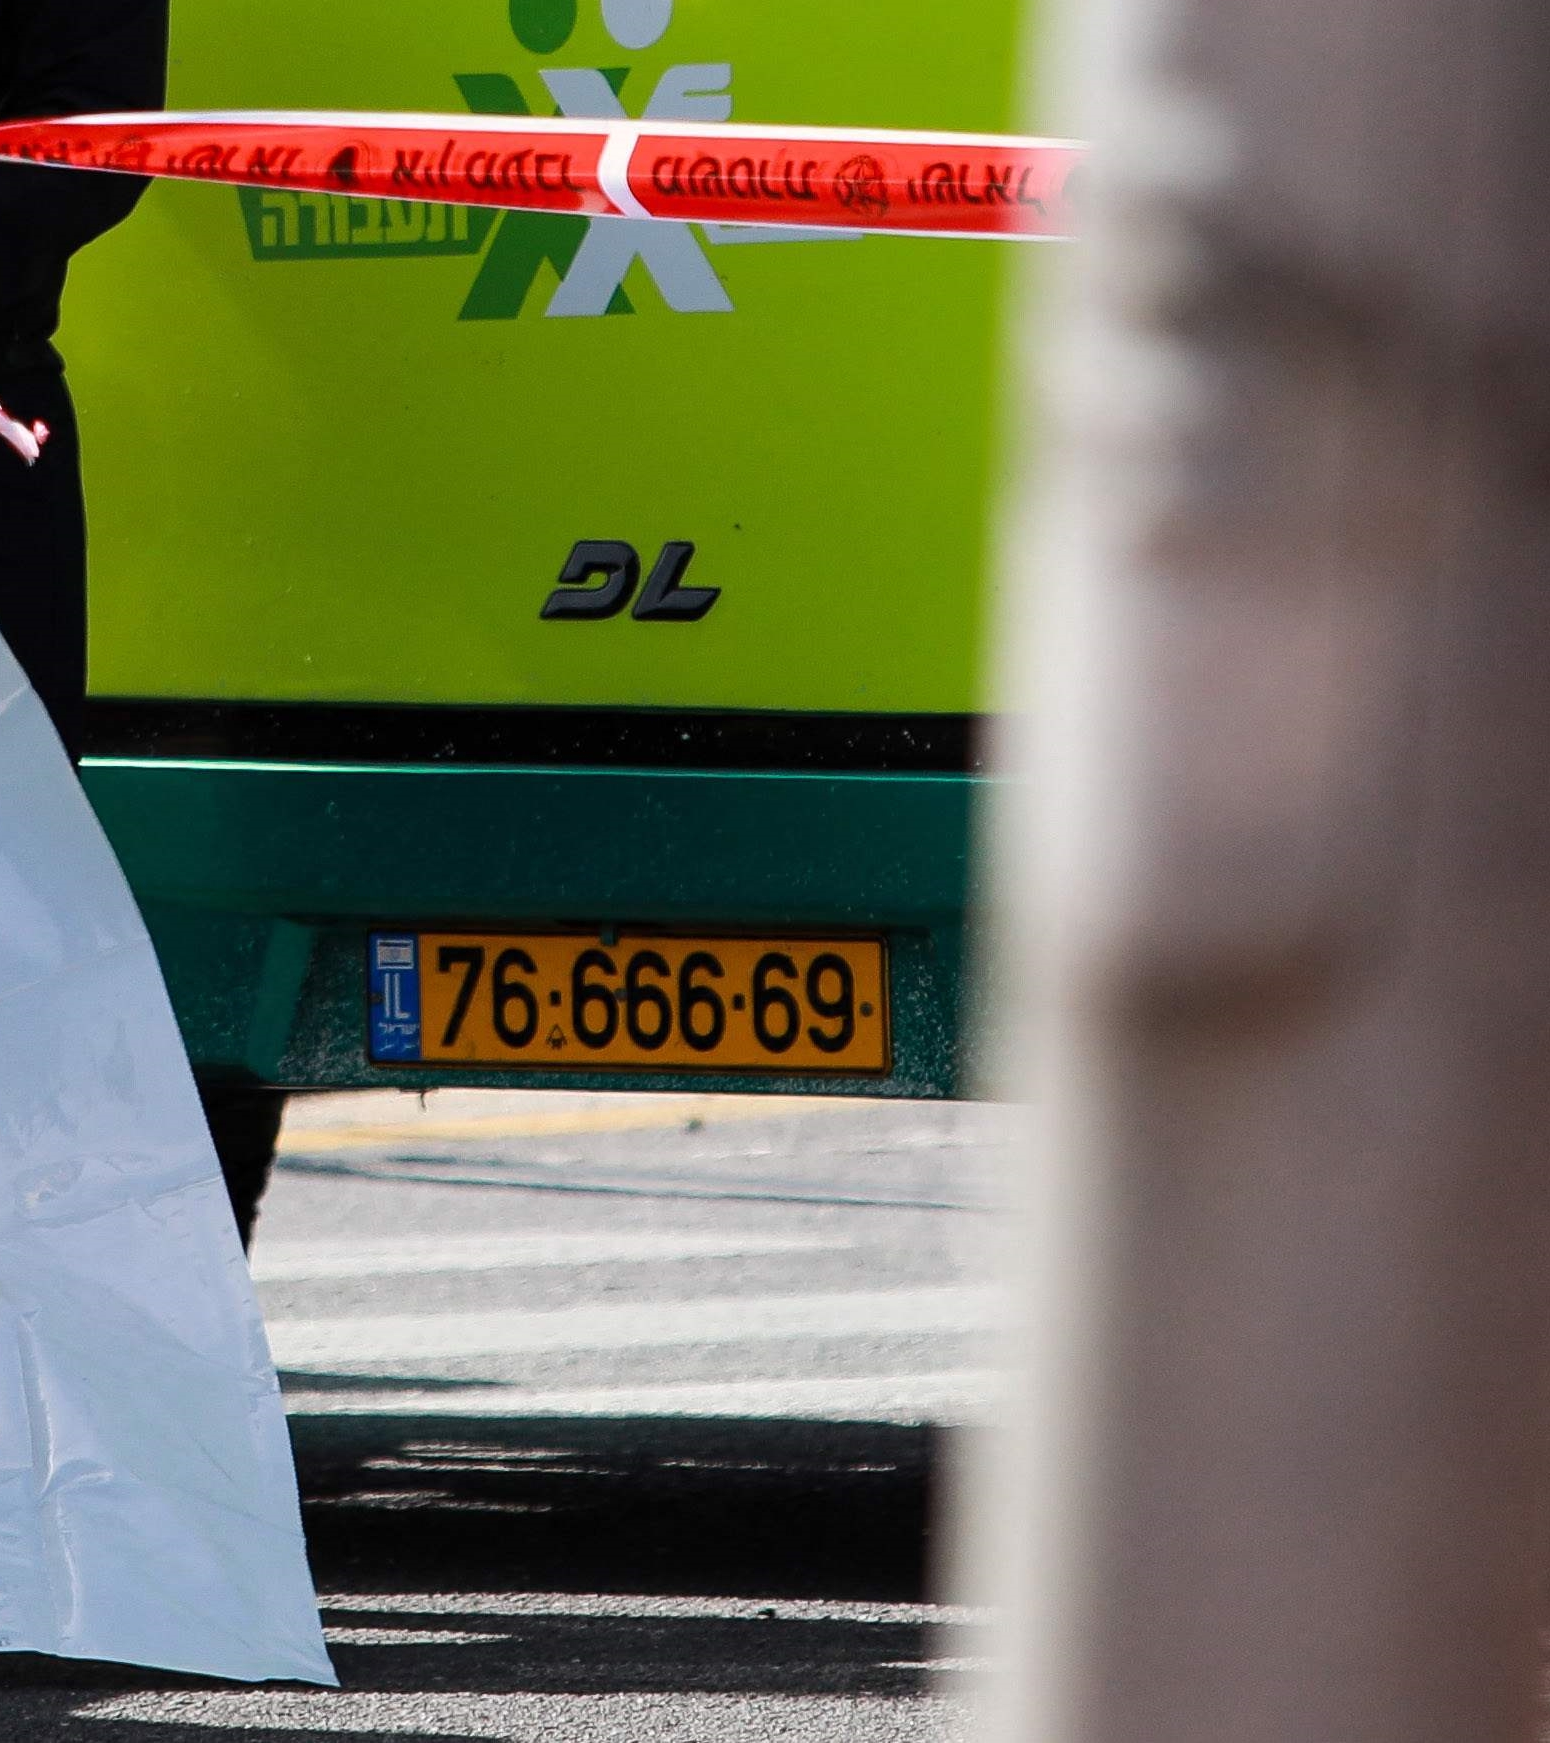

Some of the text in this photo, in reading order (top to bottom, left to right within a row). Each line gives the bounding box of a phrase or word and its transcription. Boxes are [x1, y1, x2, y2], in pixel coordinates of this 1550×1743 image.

[390, 137, 457, 190] אין
[463, 145, 585, 193] מעבר
[652, 152, 820, 201] משטרת
[538, 538, 723, 622] DL
